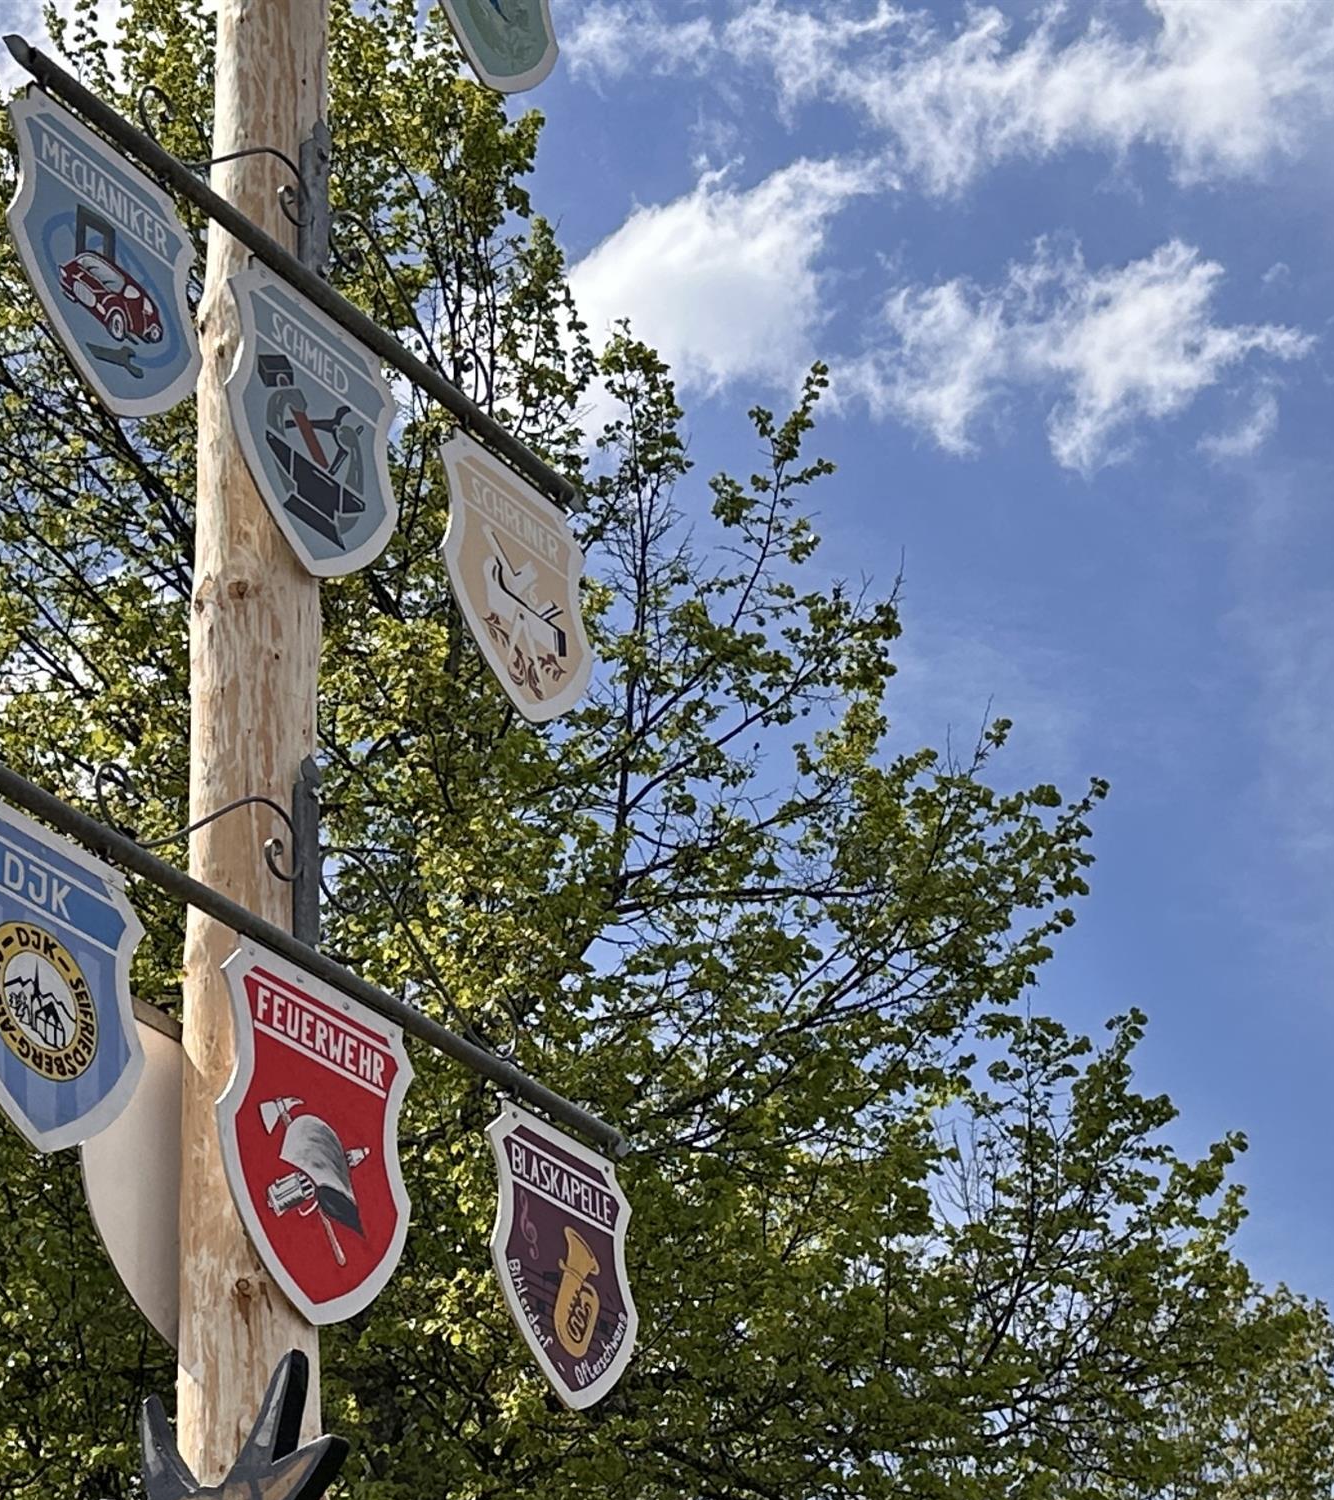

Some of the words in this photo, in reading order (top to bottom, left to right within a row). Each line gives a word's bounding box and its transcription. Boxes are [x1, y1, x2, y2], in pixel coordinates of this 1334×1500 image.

[41, 132, 168, 256] MECHANIKER
[271, 311, 349, 394] SCHMIED
[471, 477, 560, 563] SCHREINER
[3, 851, 73, 920] DJK
[15, 926, 58, 961] DJK
[257, 986, 385, 1087] FEUERWEHR
[511, 1142, 612, 1226] BLASKAPELLE
[508, 1258, 554, 1349] Bihlerdorf
